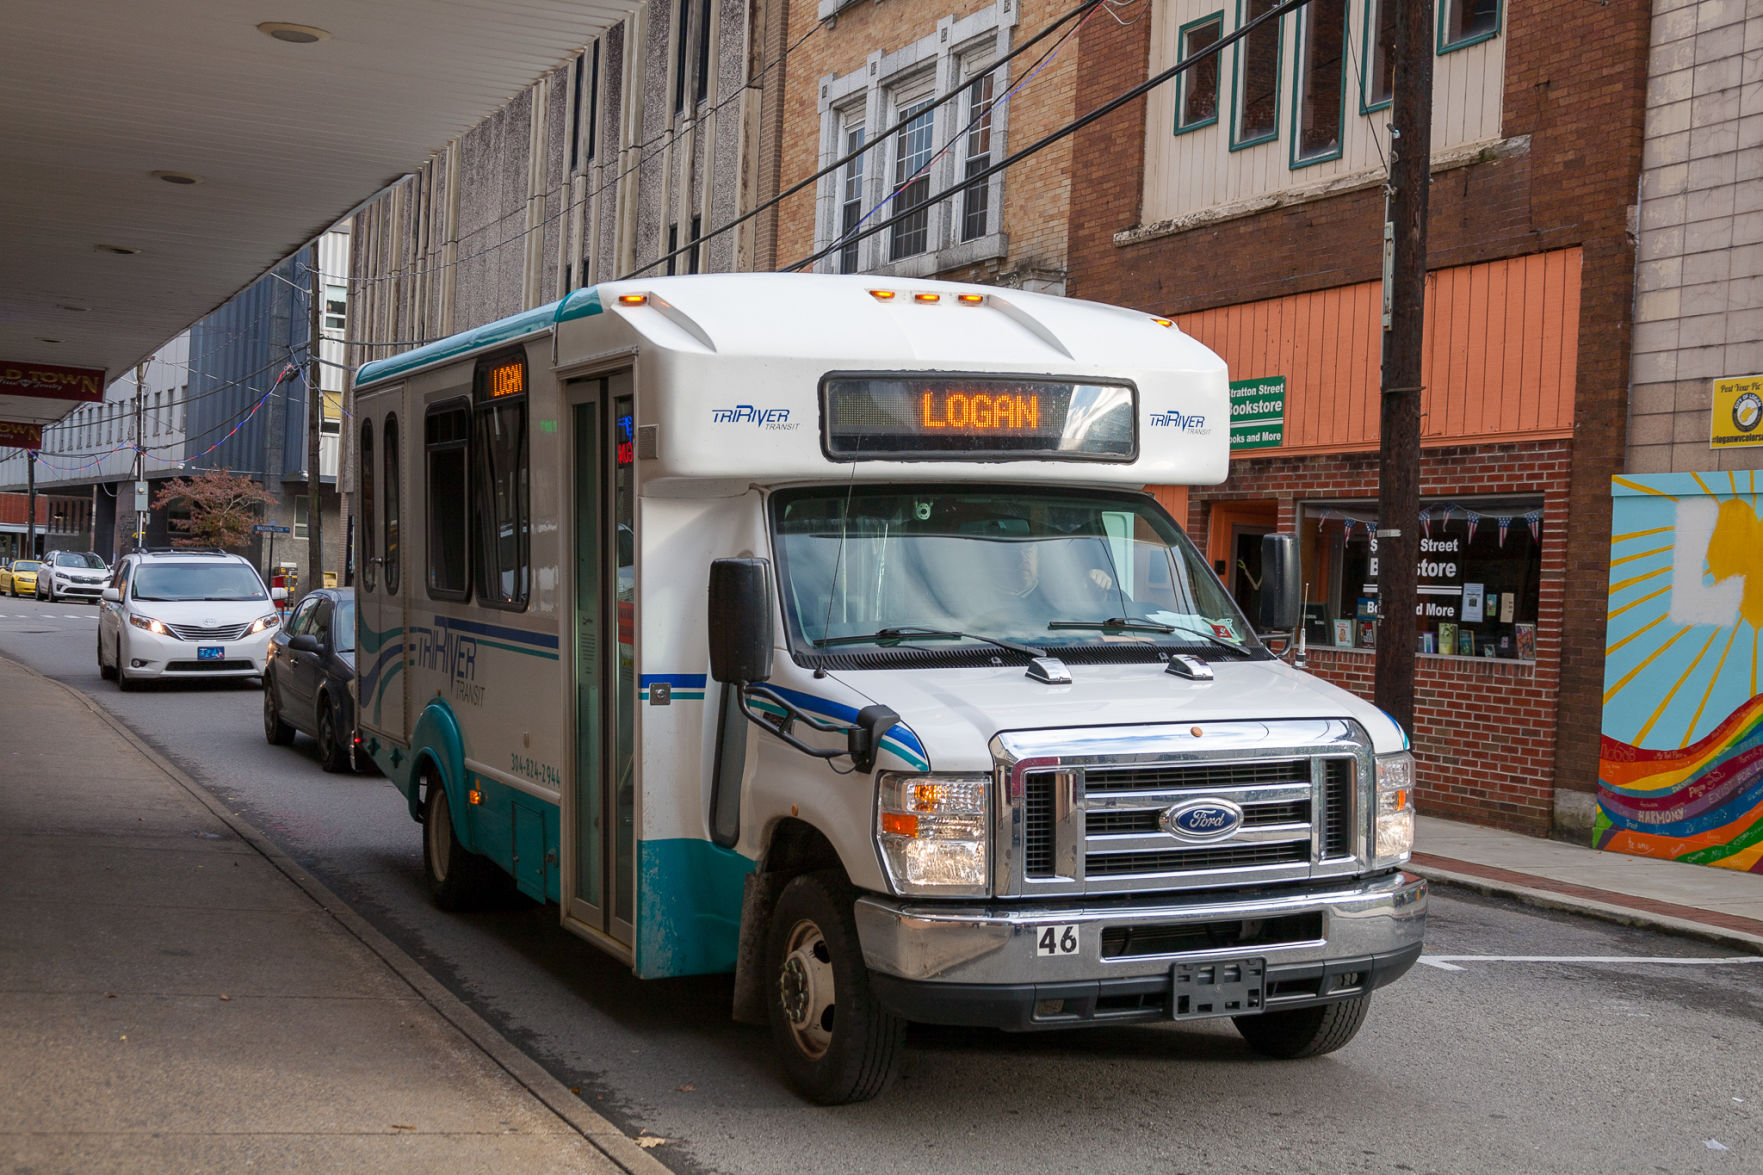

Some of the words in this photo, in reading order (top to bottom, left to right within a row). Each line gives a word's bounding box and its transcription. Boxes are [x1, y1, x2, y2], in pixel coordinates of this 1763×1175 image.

[28, 370, 100, 394] TOWN
[494, 363, 522, 397] LOGAN
[1229, 386, 1257, 398] tratton
[1258, 382, 1285, 395] Street
[923, 392, 1037, 429] LOGAN
[0, 424, 41, 442] OWN
[765, 423, 800, 431] TRANSIT
[1187, 428, 1211, 436] TRANSIT
[1230, 434, 1245, 444] ooks
[1246, 432, 1260, 443] and
[1262, 431, 1282, 442] More
[1420, 538, 1459, 552] Street
[1370, 557, 1457, 578] Btore
[1426, 603, 1455, 617] More
[456, 680, 486, 708] TRANSIT
[1190, 809, 1225, 828] Ford
[1638, 808, 1684, 825] HARMONY
[1039, 925, 1077, 954] 46
